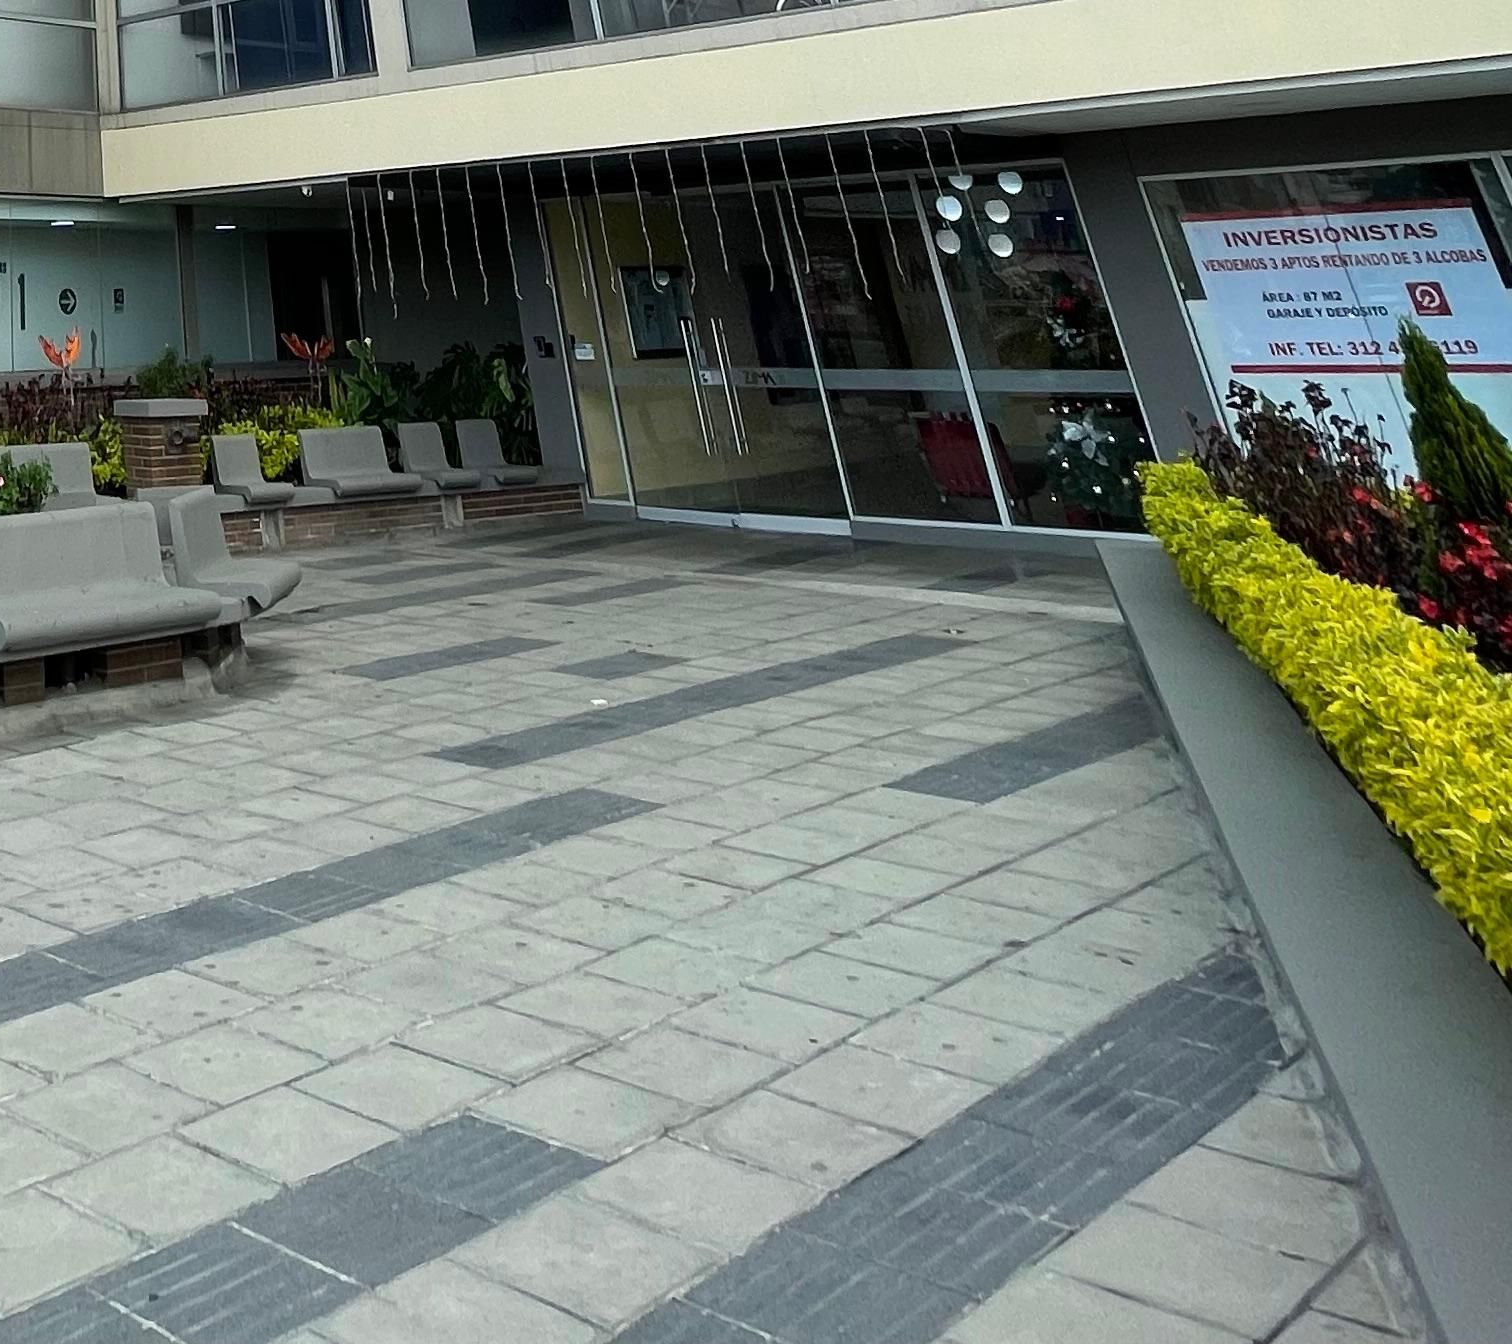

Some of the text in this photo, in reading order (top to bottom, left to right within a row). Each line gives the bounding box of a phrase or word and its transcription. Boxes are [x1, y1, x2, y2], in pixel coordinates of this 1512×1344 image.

[1223, 221, 1438, 248] INVERSIONISTAS
[1202, 248, 1487, 272] VENDEMOS 3 APTOS RENTANDO DE 3 ALCOBAS
[18, 273, 26, 331] 1
[1322, 290, 1343, 301] M2
[1315, 307, 1323, 318] Y
[1269, 341, 1304, 356] INF.
[1305, 341, 1344, 356] TEL:
[1347, 340, 1384, 355] 312
